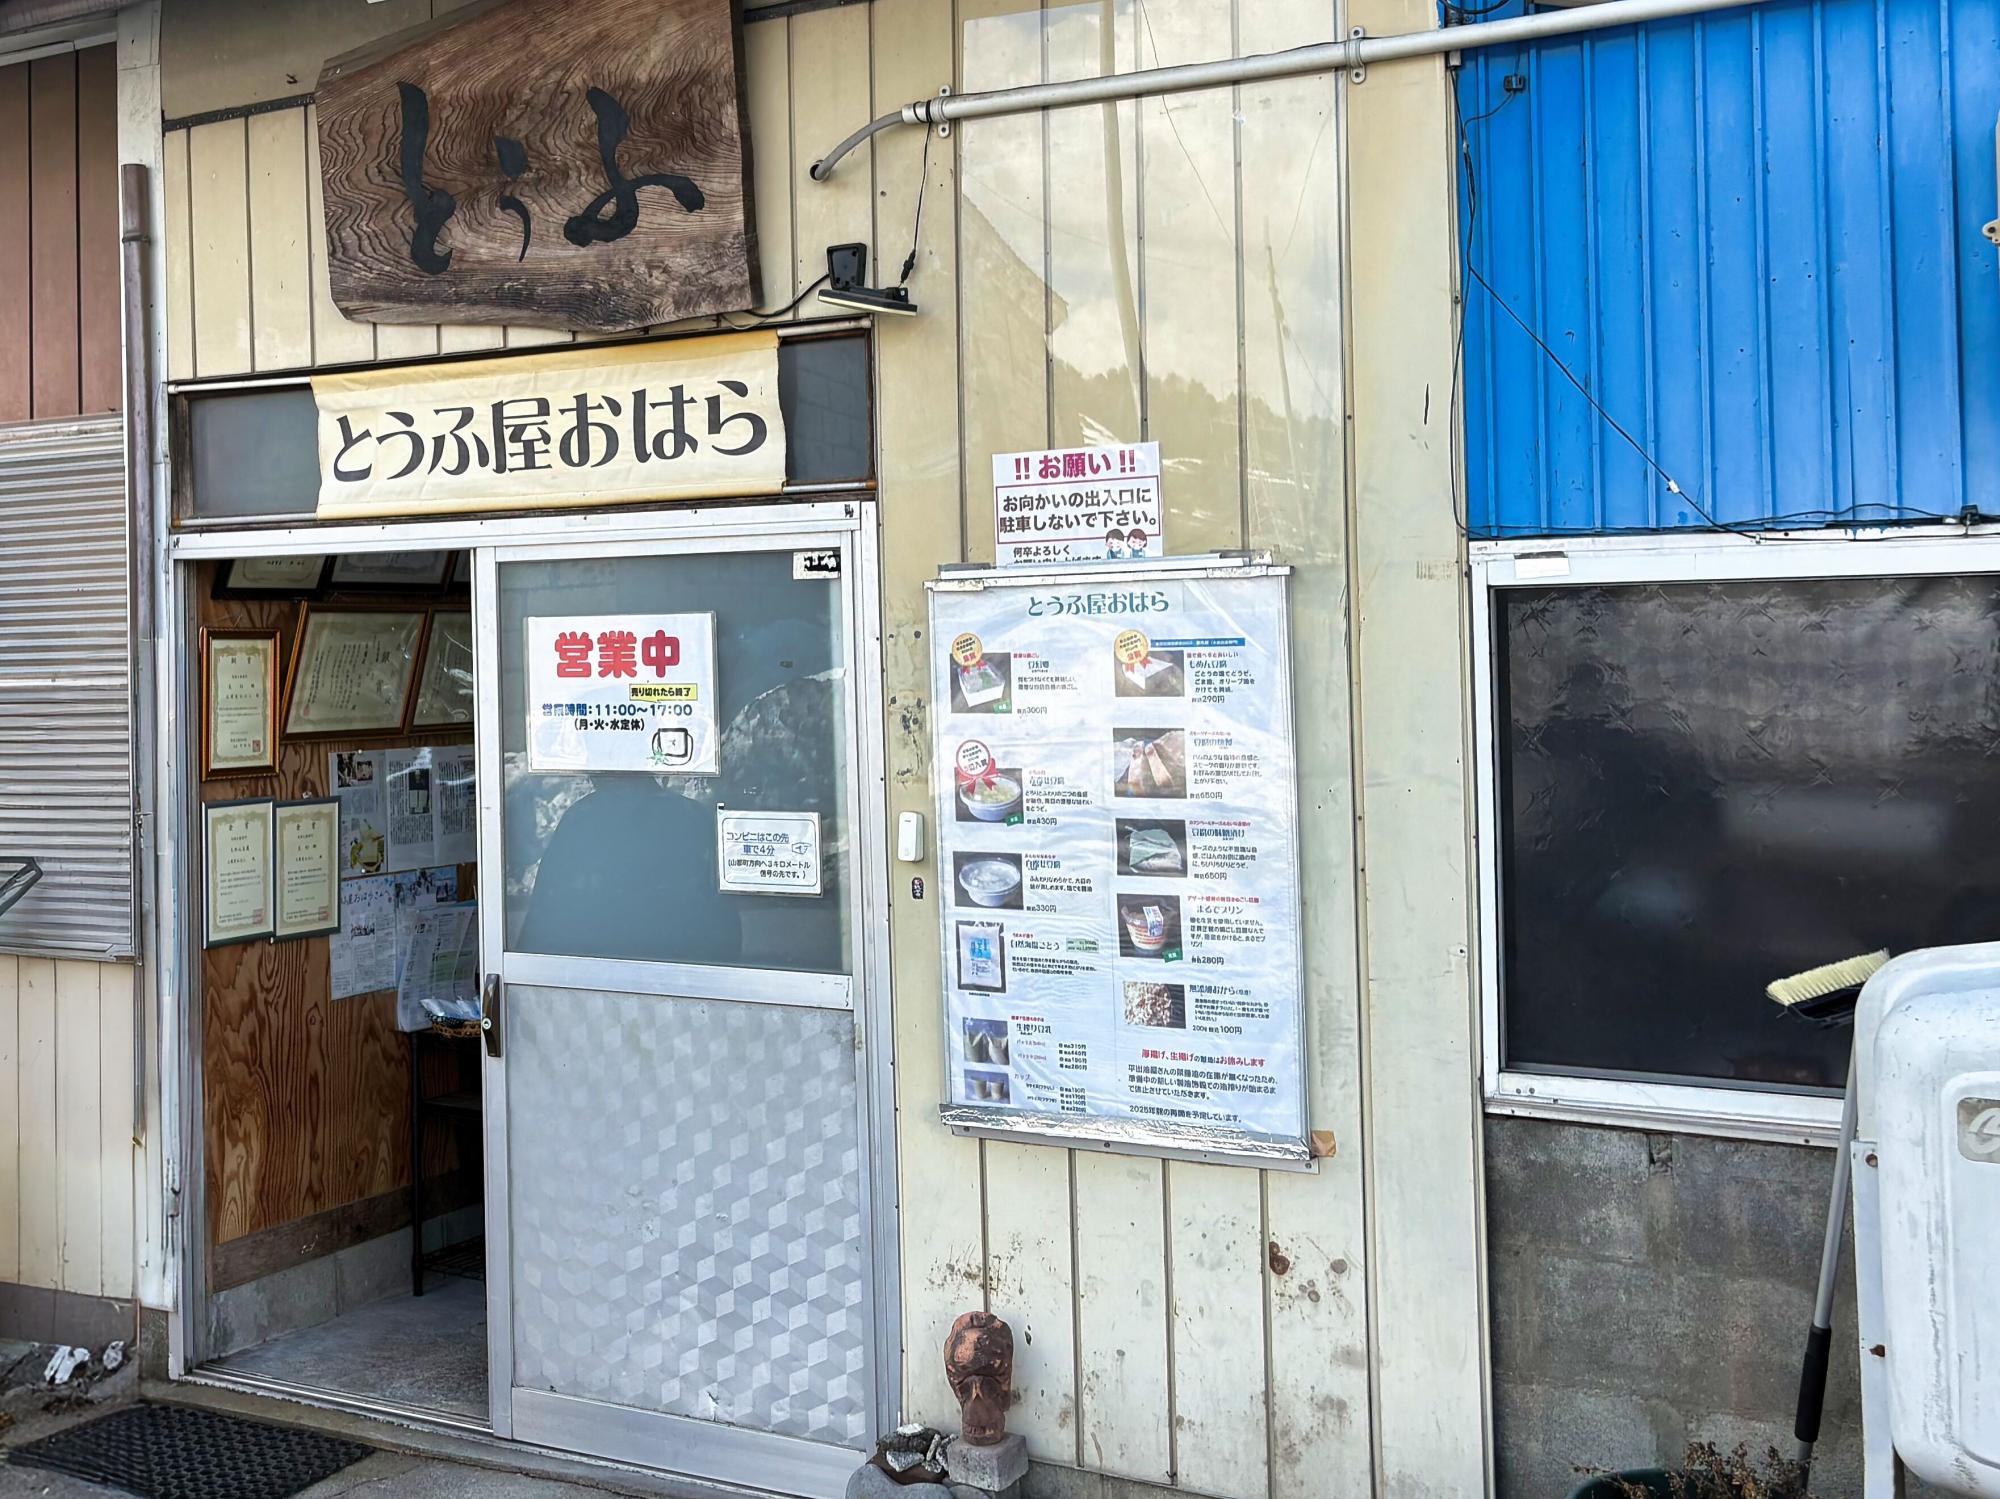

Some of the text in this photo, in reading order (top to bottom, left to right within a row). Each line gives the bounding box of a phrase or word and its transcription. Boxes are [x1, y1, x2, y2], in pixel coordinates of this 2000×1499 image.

[332, 380, 769, 484] とうふ屋おはら
[1003, 488, 1152, 512] お向かいの出入口に
[1000, 510, 1156, 533] 駐車しないで下さい。
[1013, 545, 1070, 557] 何卒よろしく
[1027, 591, 1169, 617] とうふ屋おはら
[555, 630, 679, 678] 営業中
[632, 687, 691, 697] 売り切れたら終了
[726, 832, 789, 842] コンビニはこの先
[744, 845, 775, 855] 車で4分
